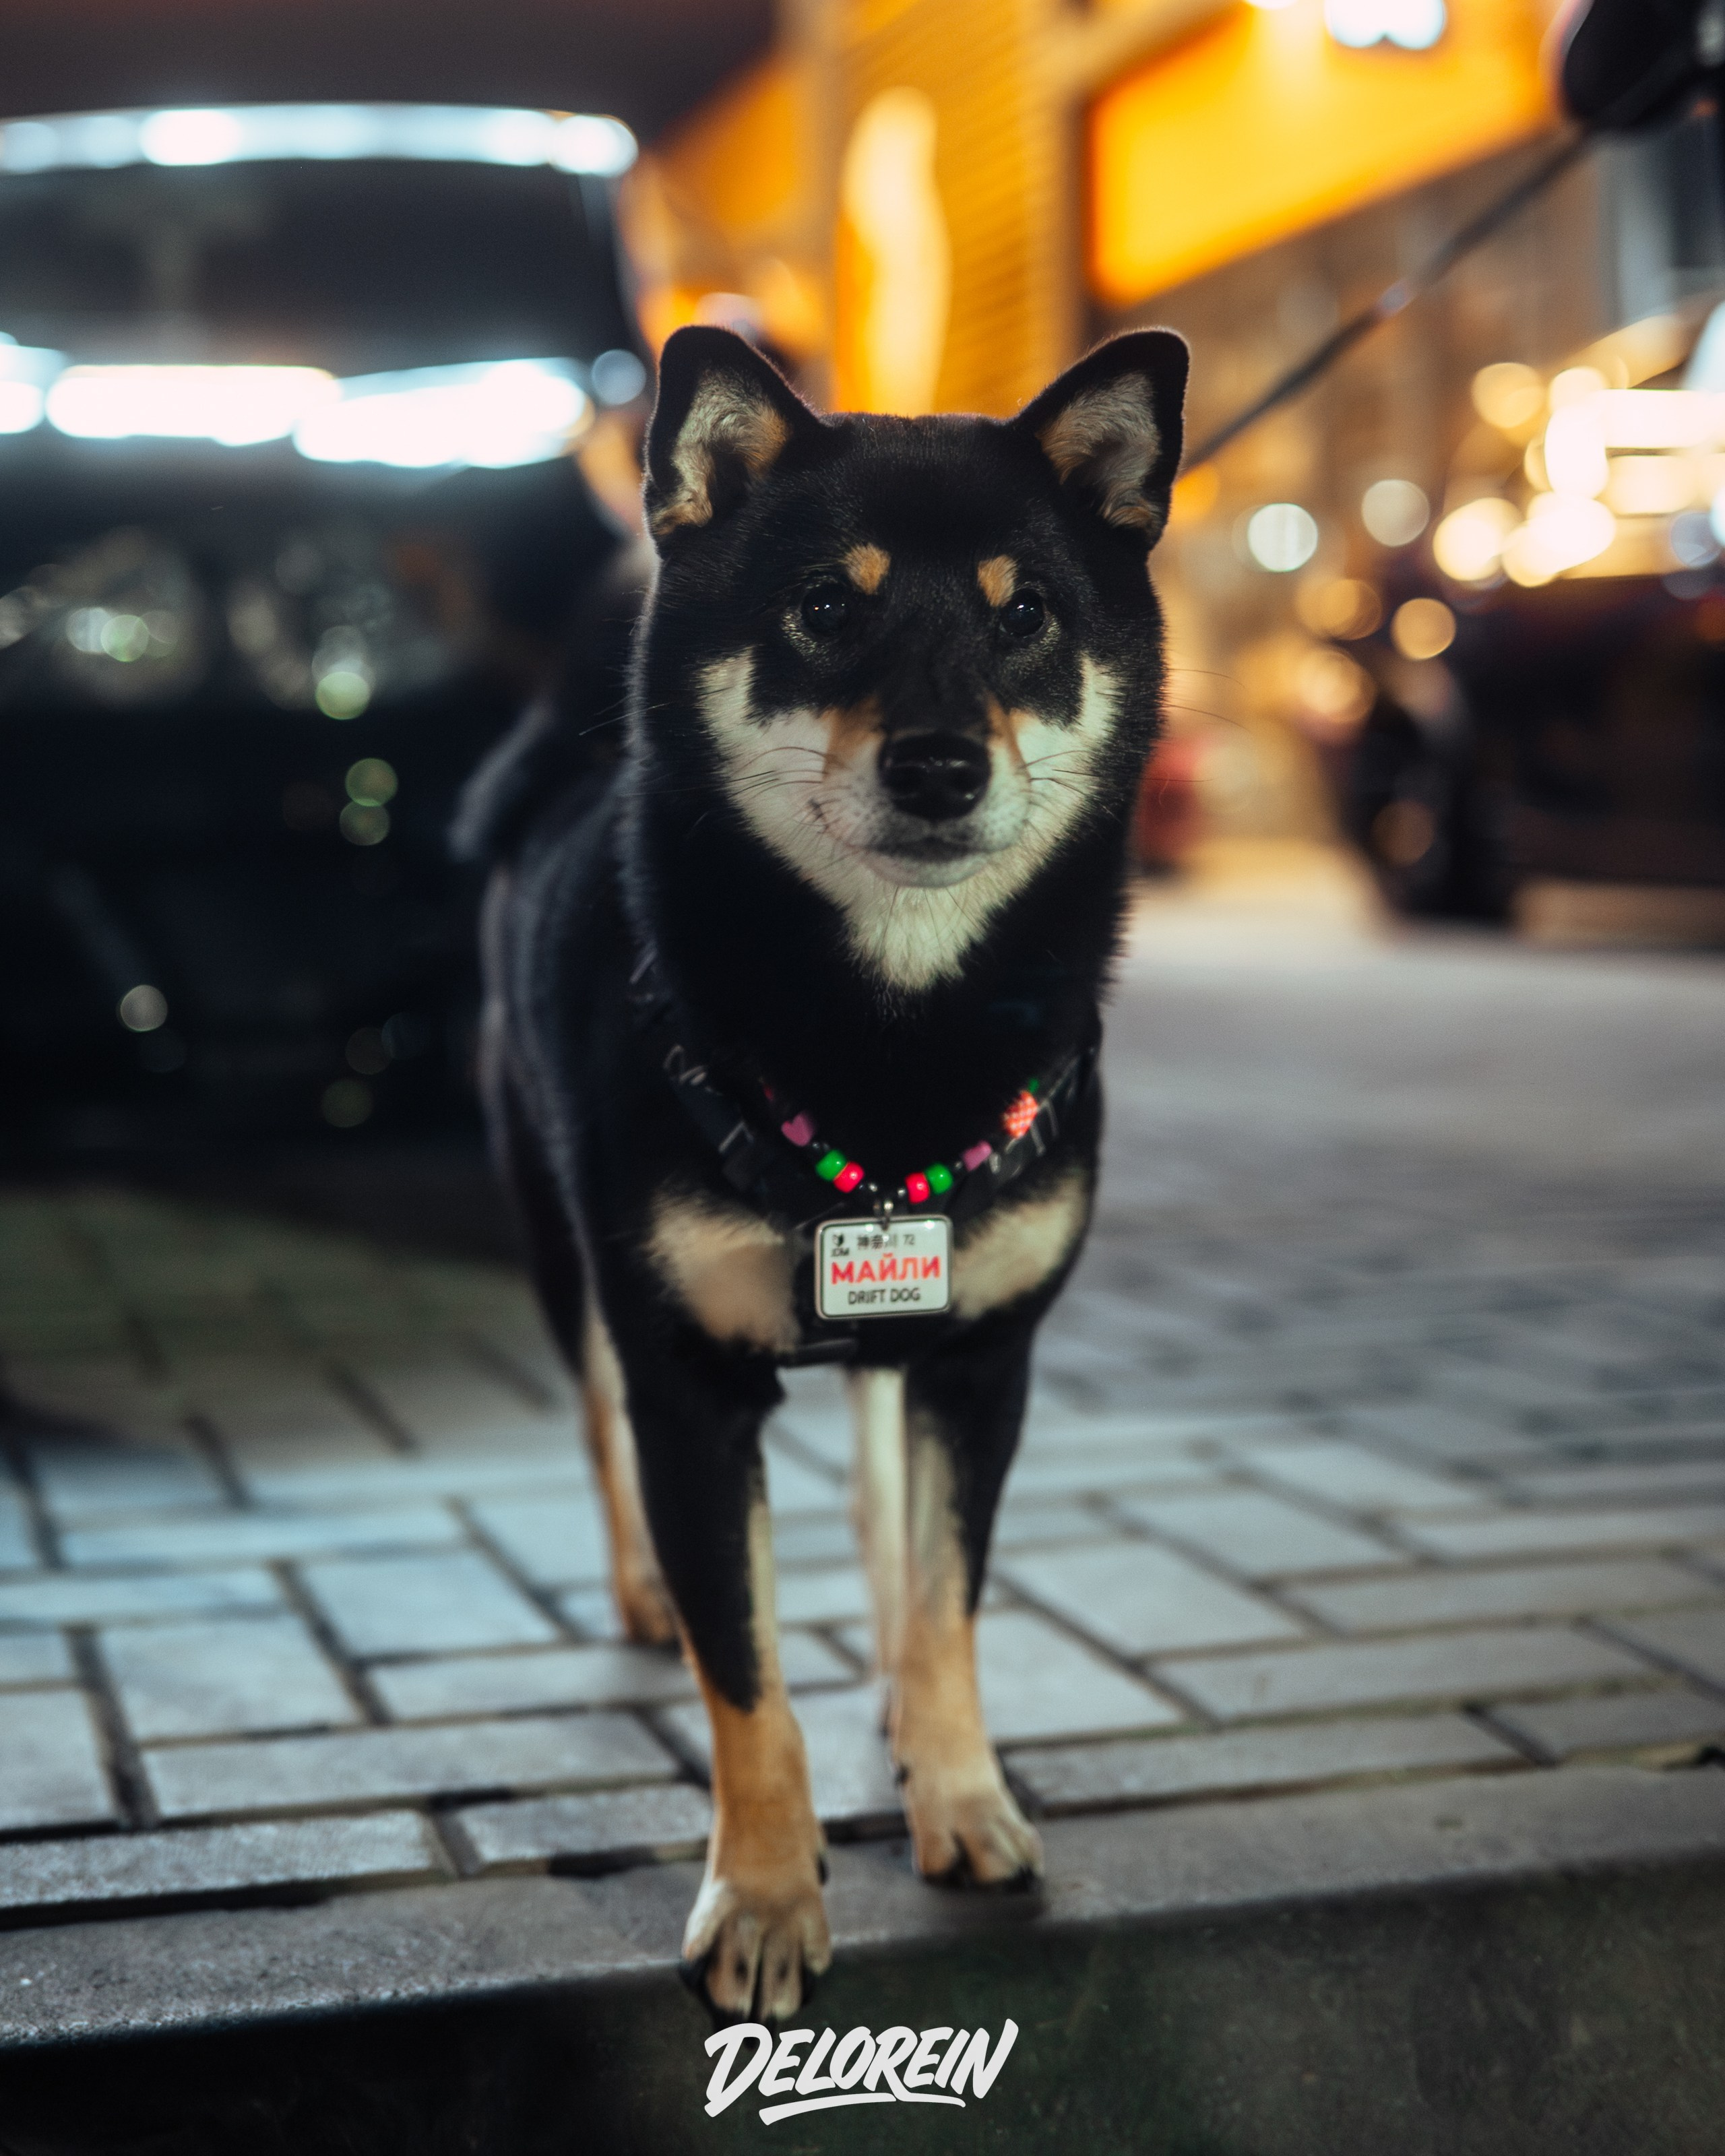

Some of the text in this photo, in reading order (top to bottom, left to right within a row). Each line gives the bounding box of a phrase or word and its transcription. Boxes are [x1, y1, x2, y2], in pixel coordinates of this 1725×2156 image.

[831, 1253, 941, 1285] МАЙЛИ
[848, 1288, 921, 1305] DRIFT DOG
